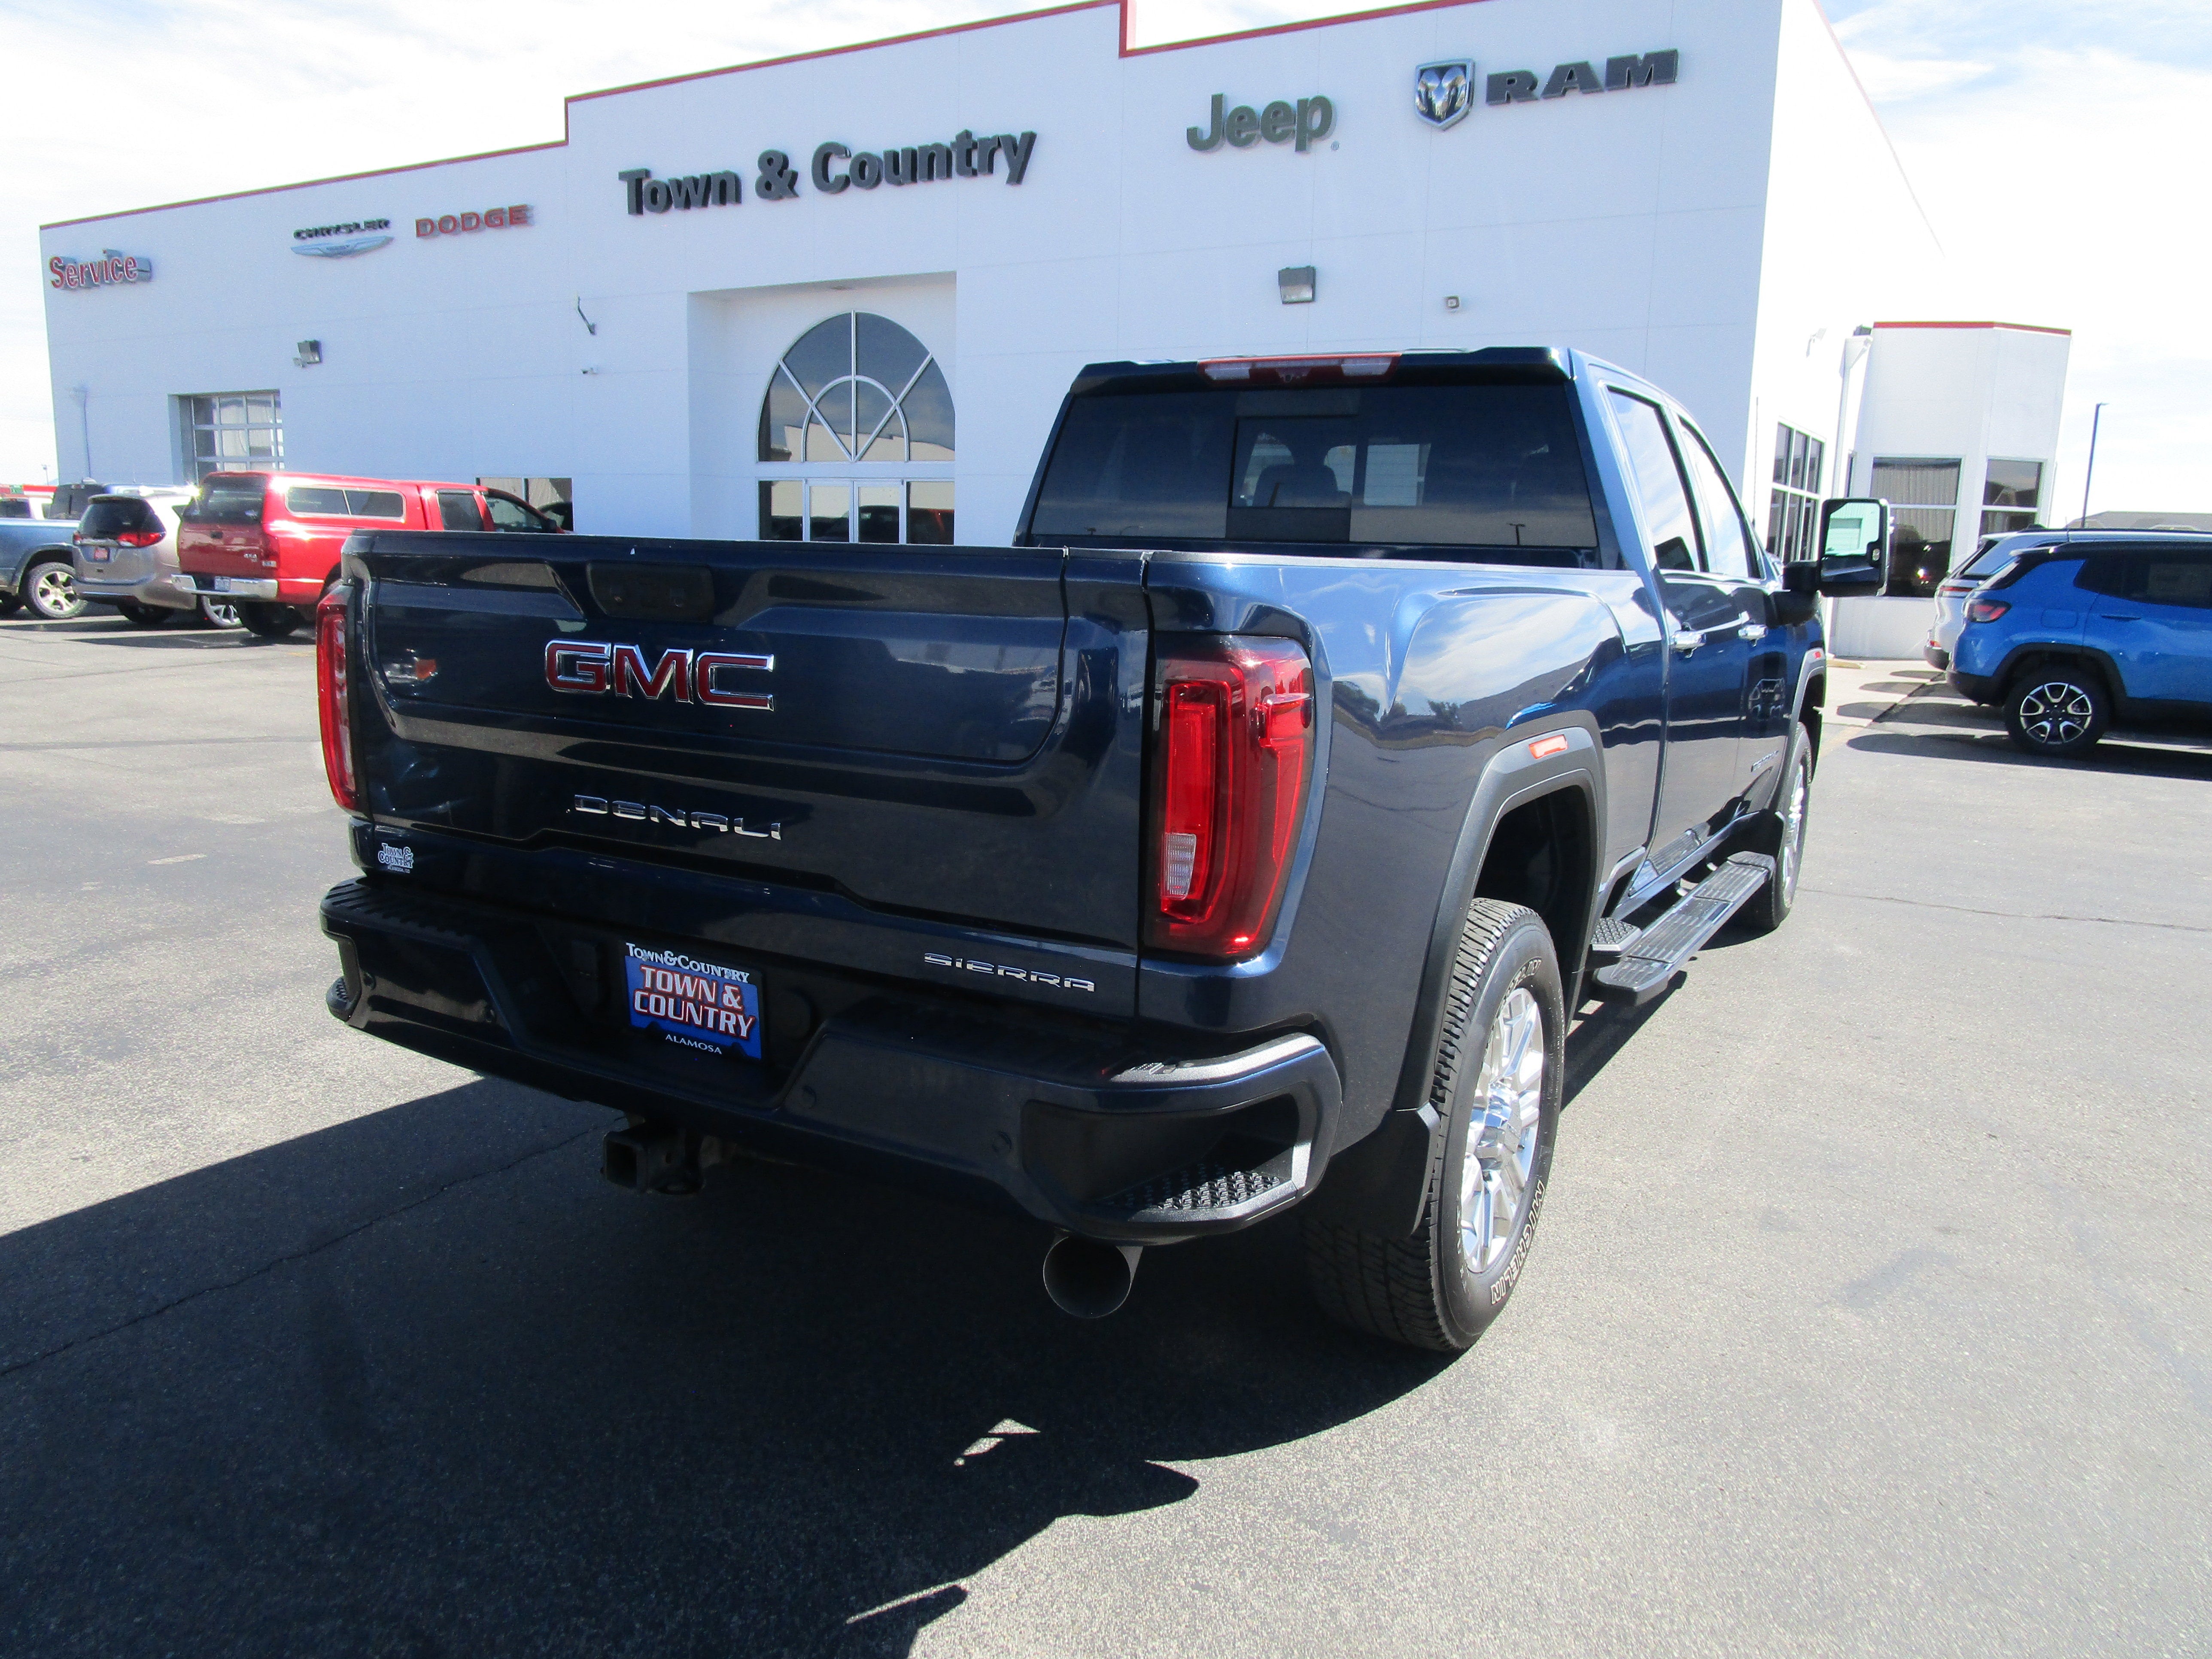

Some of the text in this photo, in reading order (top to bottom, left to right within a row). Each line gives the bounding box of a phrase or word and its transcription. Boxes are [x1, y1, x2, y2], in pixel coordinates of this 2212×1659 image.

[1487, 49, 1678, 105] RAM
[1187, 93, 1335, 152] Jeep
[619, 129, 1037, 215] Town & Country
[293, 218, 391, 240] CHRYSLER
[415, 204, 532, 237] DODGE
[49, 249, 148, 290] Service
[545, 640, 775, 711] GMC
[574, 795, 781, 840] DENALI
[640, 965, 743, 1010] TOWN &
[924, 953, 1094, 992] SIERRA
[633, 989, 756, 1039] COUNTRY
[665, 1033, 723, 1055] ALAMOSA
[1490, 1179, 1546, 1305] MICHELIN
